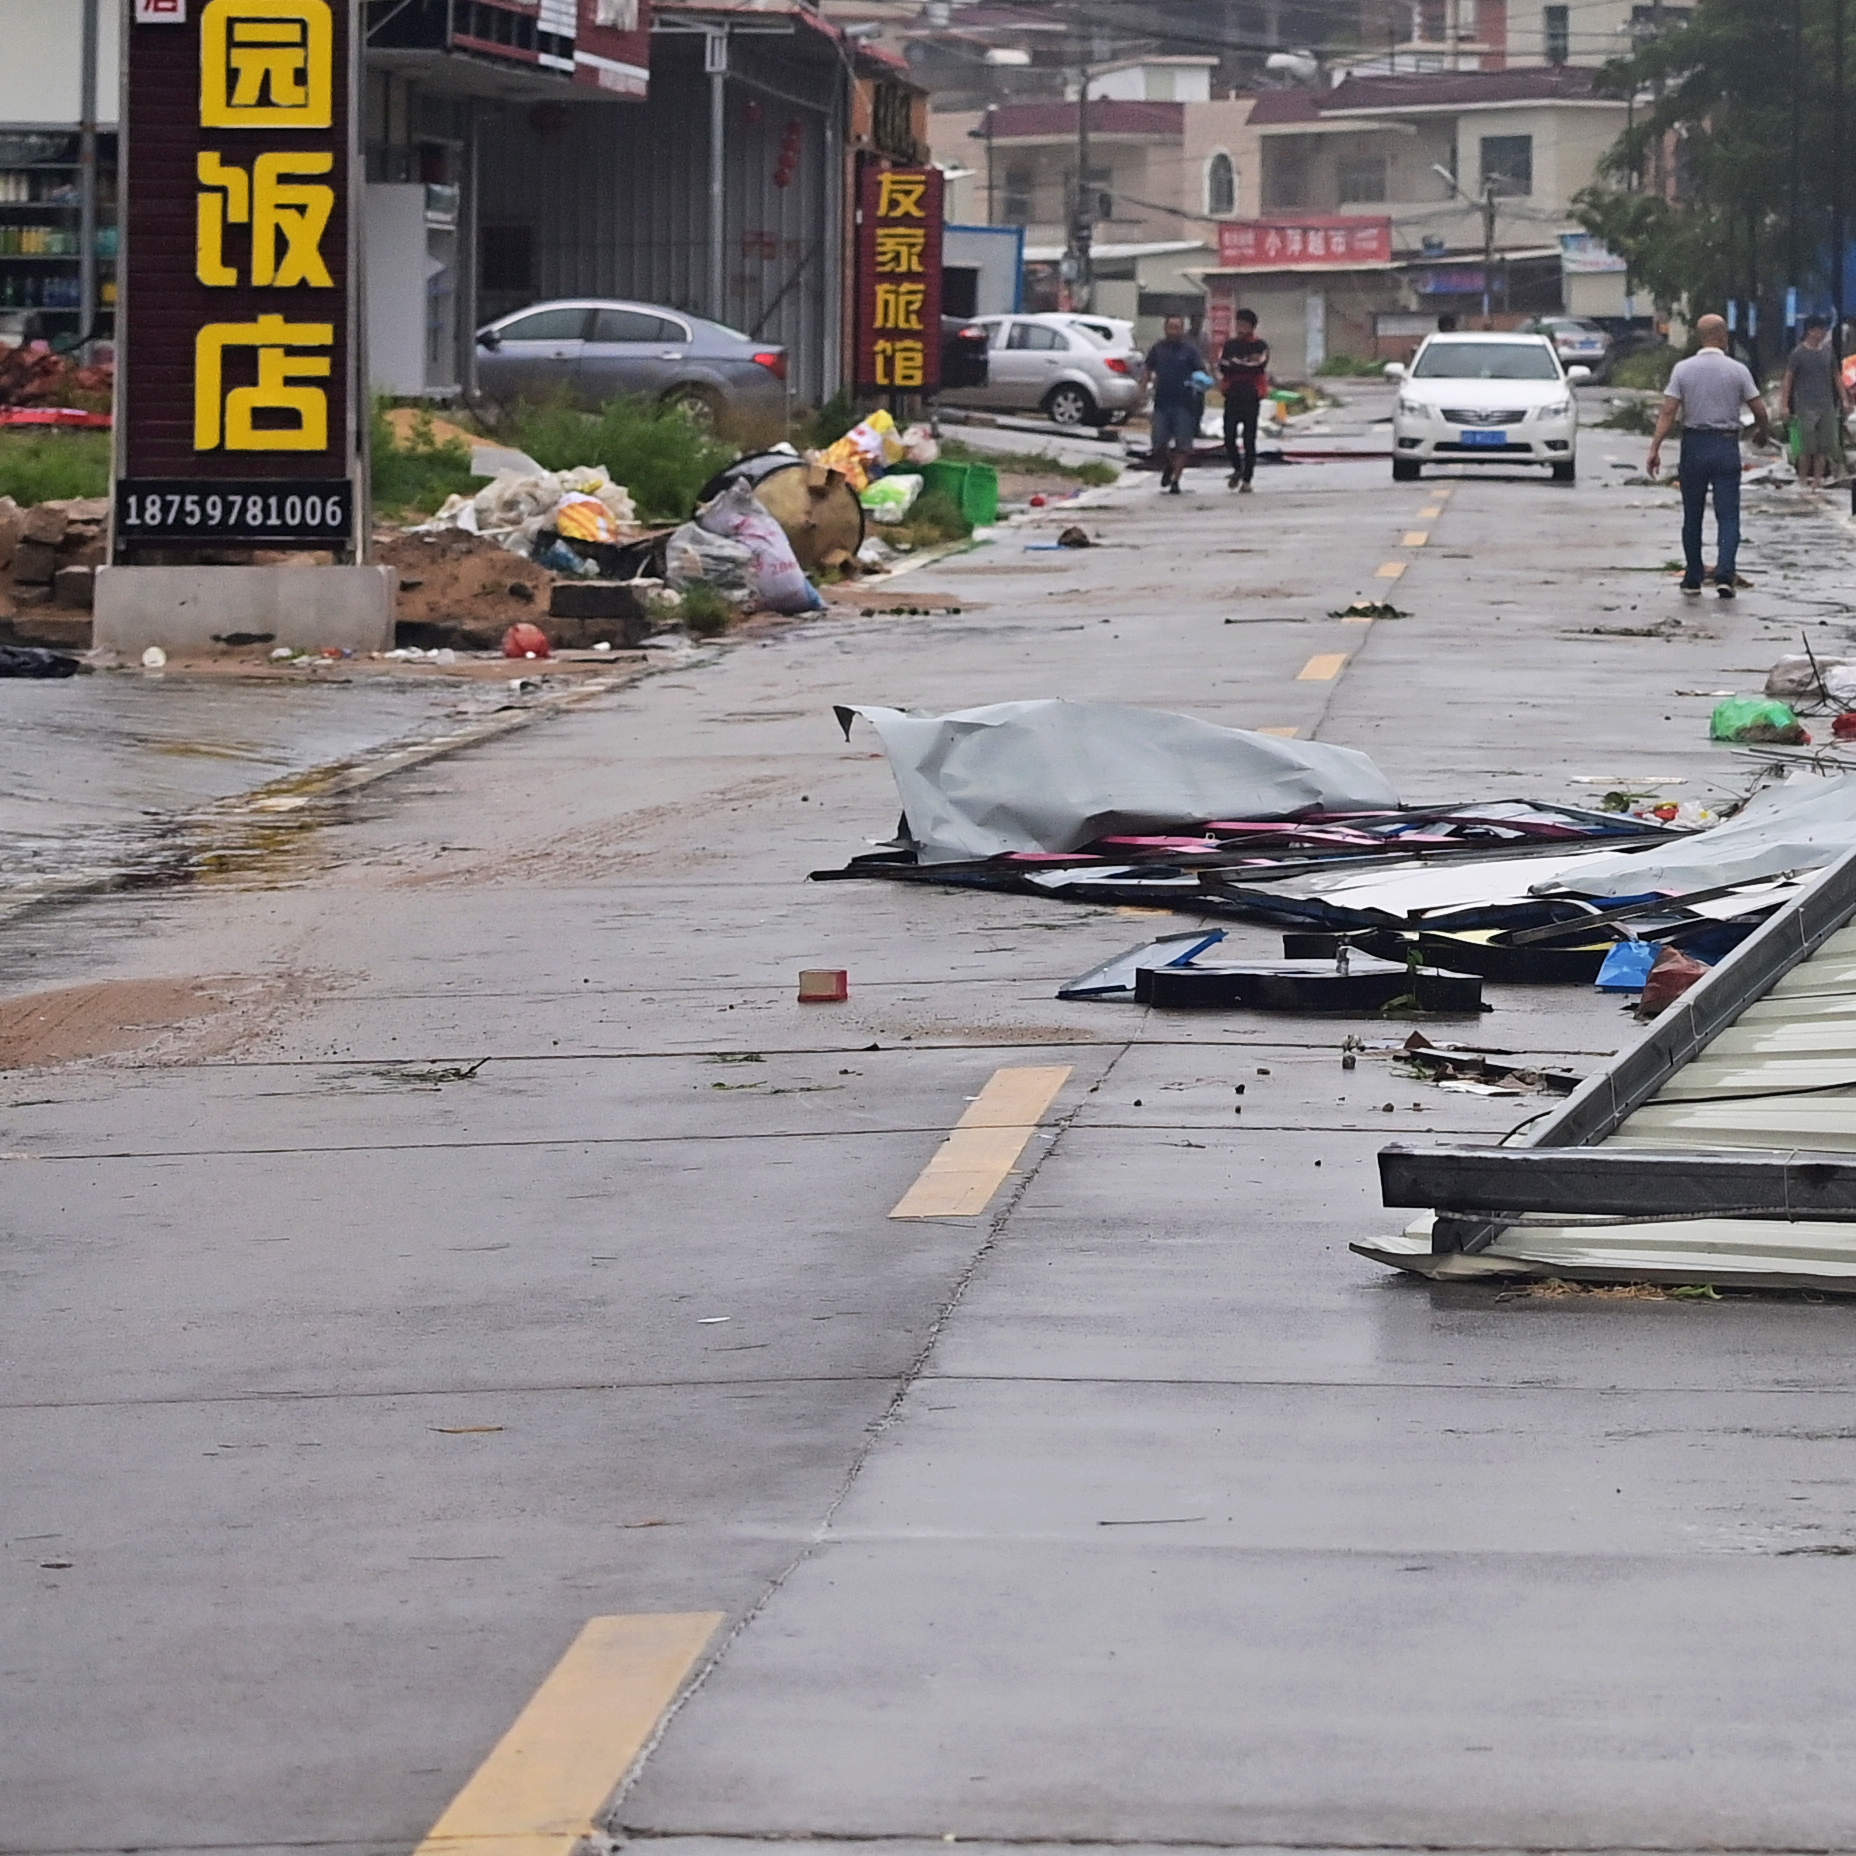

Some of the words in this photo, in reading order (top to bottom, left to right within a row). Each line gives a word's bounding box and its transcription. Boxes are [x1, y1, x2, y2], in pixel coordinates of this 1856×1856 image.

[874, 171, 926, 387] 友家旅馆
[124, 494, 343, 528] 18759781006
